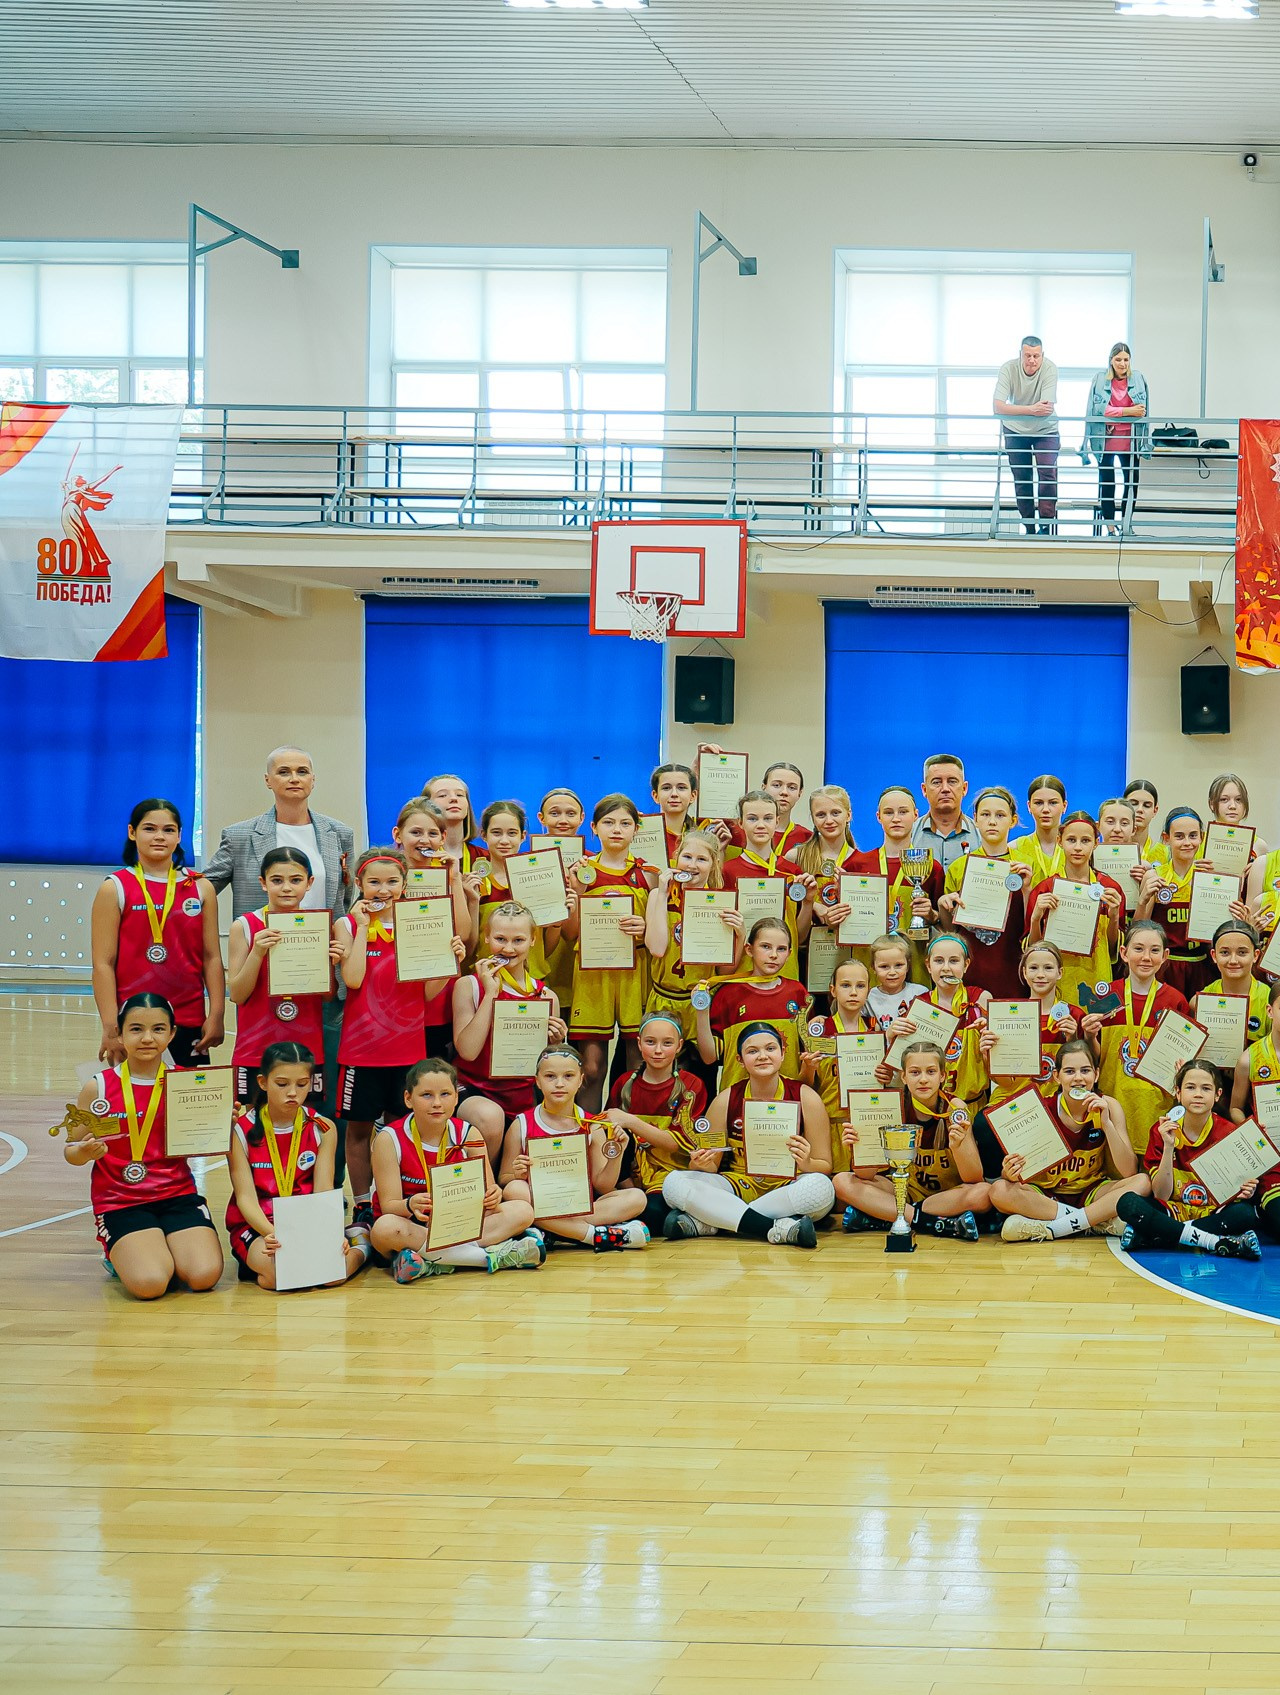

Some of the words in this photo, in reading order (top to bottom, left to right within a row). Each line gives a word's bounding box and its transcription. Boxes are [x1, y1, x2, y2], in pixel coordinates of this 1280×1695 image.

[37, 537, 77, 576] 80
[36, 582, 111, 606] ПОБЕДА!
[630, 835, 658, 844] ИПЛОМ
[518, 872, 554, 884] ДИПЛОМ
[971, 876, 1004, 887] ДИПЛОМ
[746, 897, 777, 905] ДИПЛОМ
[848, 894, 880, 903] ДИПЛОМ
[1199, 891, 1231, 901] ДИПЛОМ
[1058, 898, 1091, 911] ДИПЛОМ
[692, 911, 721, 919] ДИПЛО
[405, 921, 444, 932] ДИПЛОМ
[279, 935, 320, 945] ДИПЛОМ
[1204, 1015, 1238, 1025] ДИПЛОМ
[503, 1022, 540, 1030] ДИПЛОМ
[996, 1023, 1032, 1031] ДИПЛОМ
[1164, 1032, 1192, 1054] ДИПЛОМ
[845, 1054, 878, 1063] ДИПЛОМ
[238, 1066, 248, 1095] ИМПУ
[178, 1094, 223, 1104] ДИПЛОМ
[858, 1113, 894, 1121] ДИПЛОМ
[753, 1123, 789, 1131] ДИПЛОМ
[1006, 1112, 1040, 1136] ДИПЛОМ
[1233, 1139, 1259, 1171] ДИПЛОМ
[540, 1158, 578, 1168] ДИПЛОМ
[940, 1156, 950, 1169] 5
[441, 1184, 477, 1198] ДИПЛОМ
